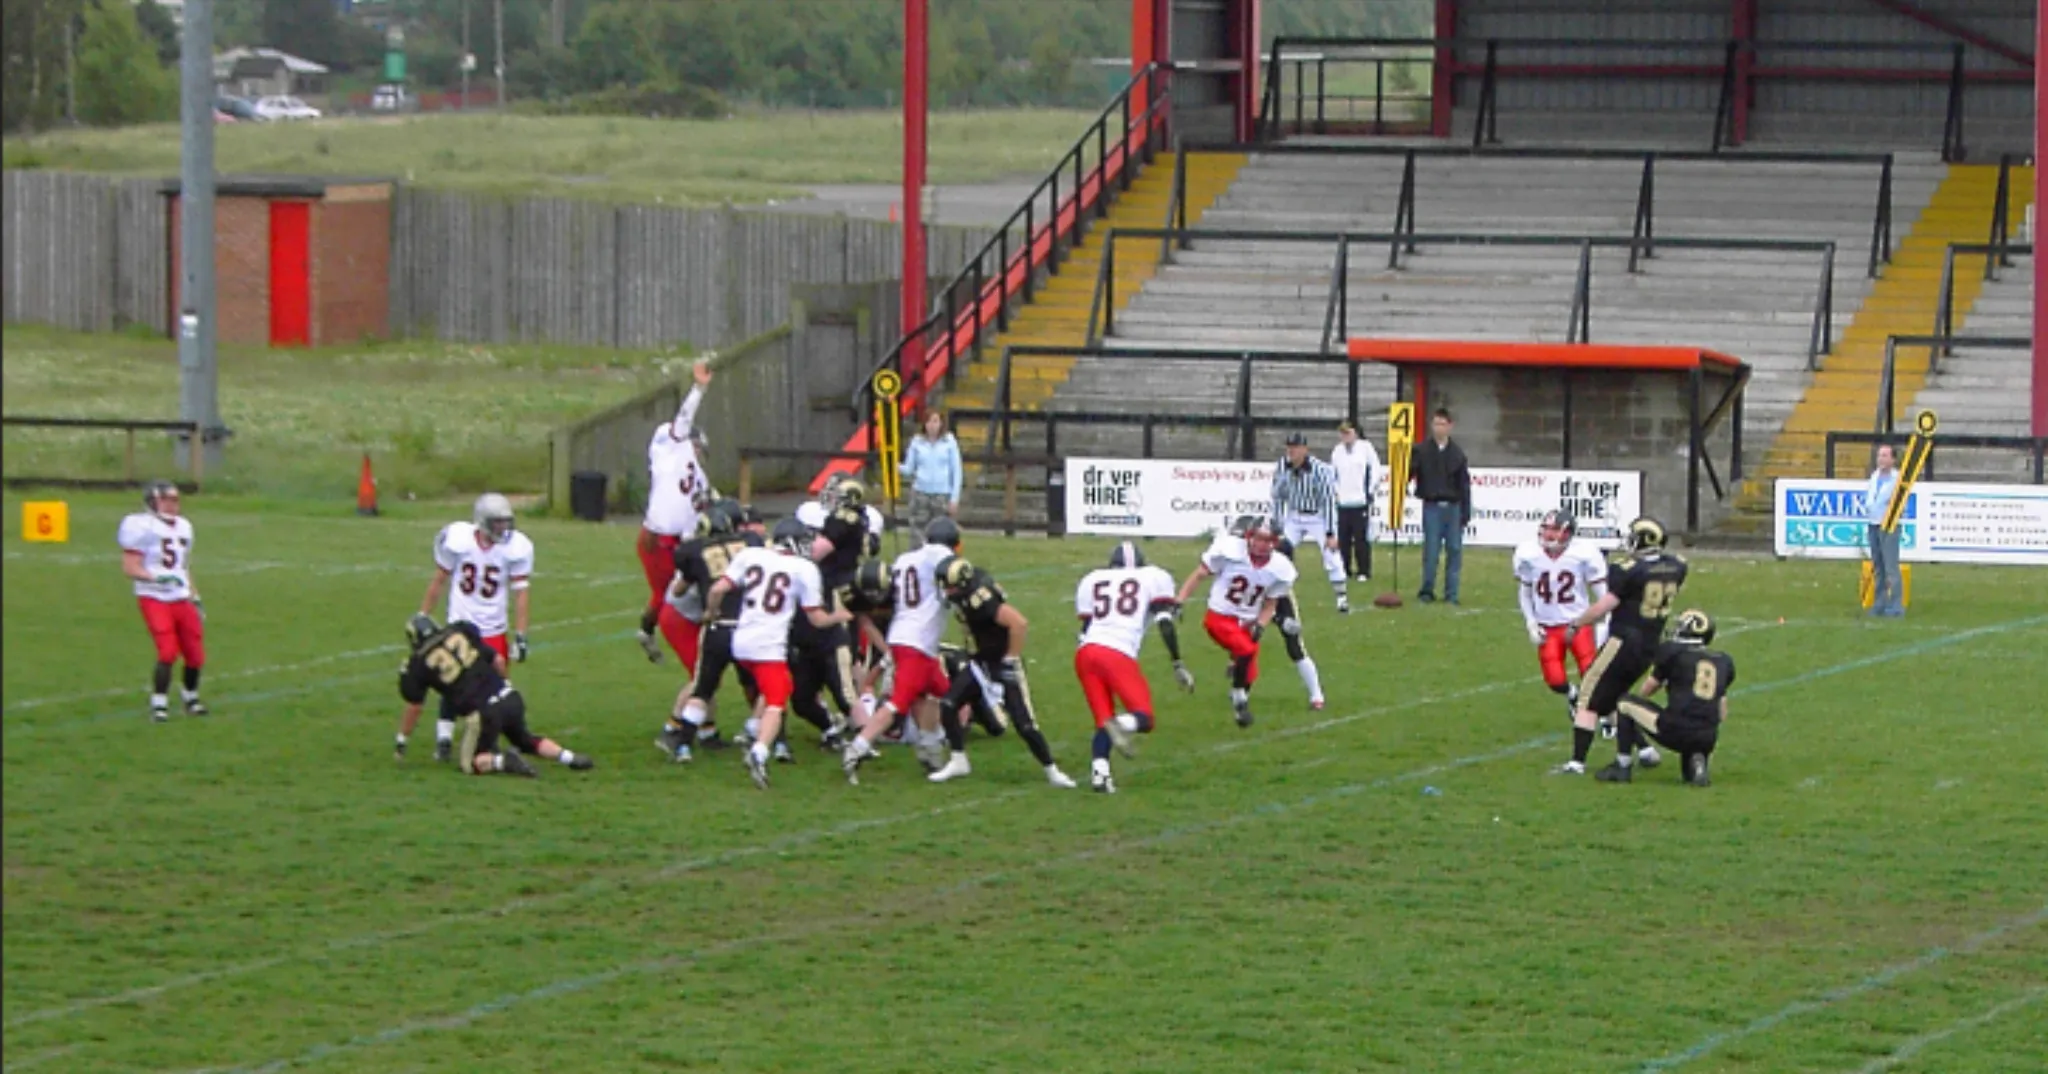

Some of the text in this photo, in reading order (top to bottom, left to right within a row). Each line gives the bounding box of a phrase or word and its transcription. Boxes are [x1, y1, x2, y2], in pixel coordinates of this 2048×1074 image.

[1391, 407, 1411, 437] 4
[1083, 464, 1142, 486] drver
[1172, 466, 1245, 481] Supplying
[1470, 474, 1547, 488] NDUSTRY
[1083, 486, 1127, 505] HIRE
[1560, 476, 1620, 498] drver
[1171, 498, 1274, 513] Contact 0192
[1560, 497, 1604, 518] HIRE
[1793, 492, 1869, 517] WALK
[1788, 522, 1913, 547] SIGS
[460, 562, 500, 599] 35
[742, 564, 791, 614] 26
[1224, 575, 1264, 607] 21
[1535, 569, 1576, 604] 42
[1092, 578, 1141, 618] 58
[425, 632, 479, 685] 32
[1694, 660, 1717, 700] 8
